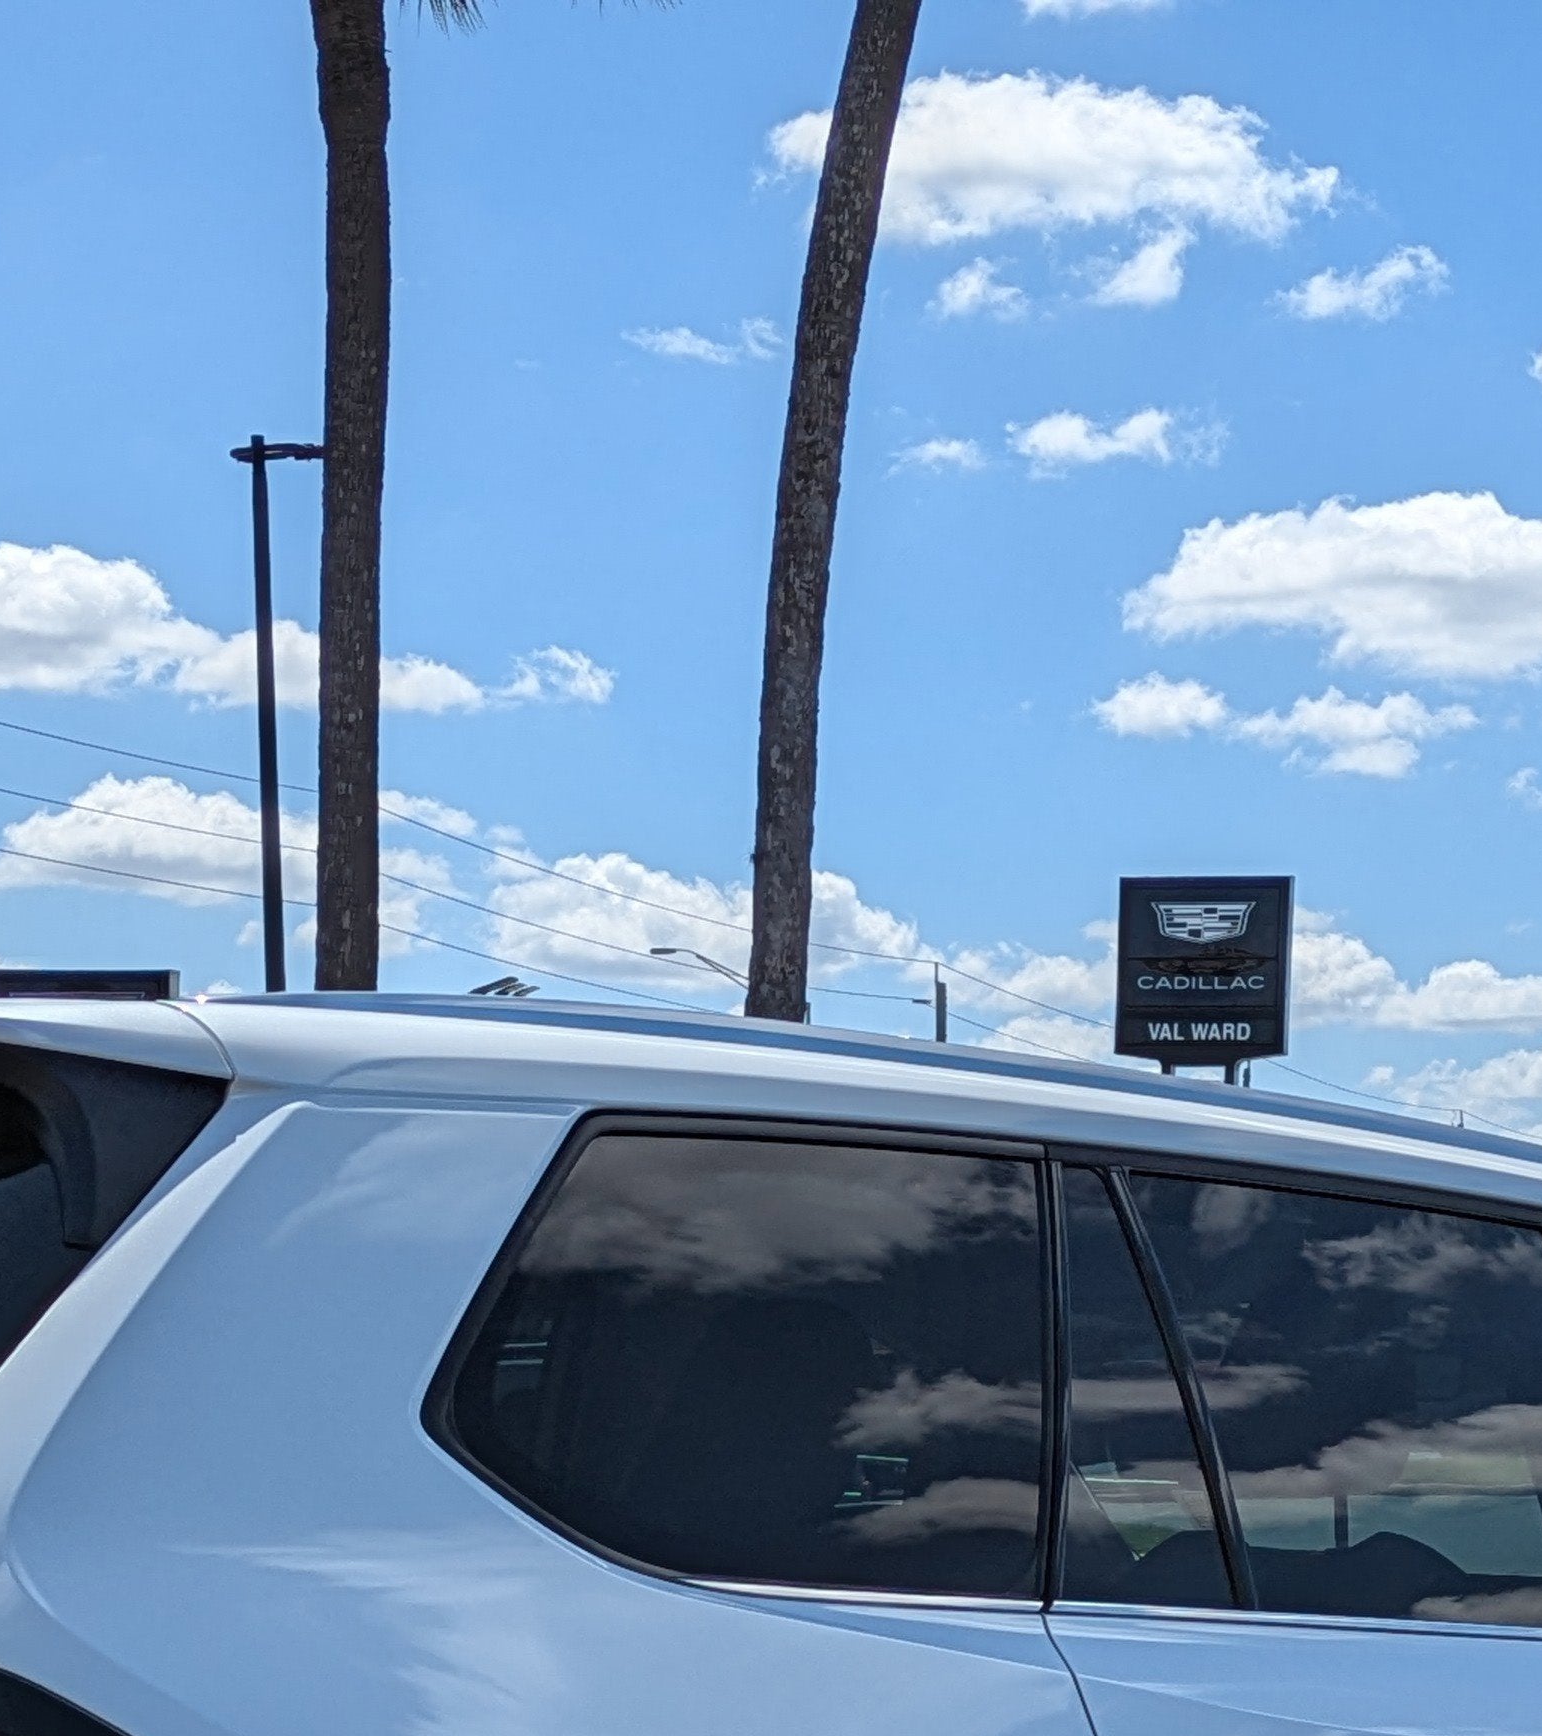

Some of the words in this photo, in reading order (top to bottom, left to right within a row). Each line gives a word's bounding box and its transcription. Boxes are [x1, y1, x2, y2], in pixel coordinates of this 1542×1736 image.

[1137, 976, 1265, 990] CADILLAC
[1148, 1022, 1185, 1041] VAL
[1191, 1022, 1252, 1041] WARD
